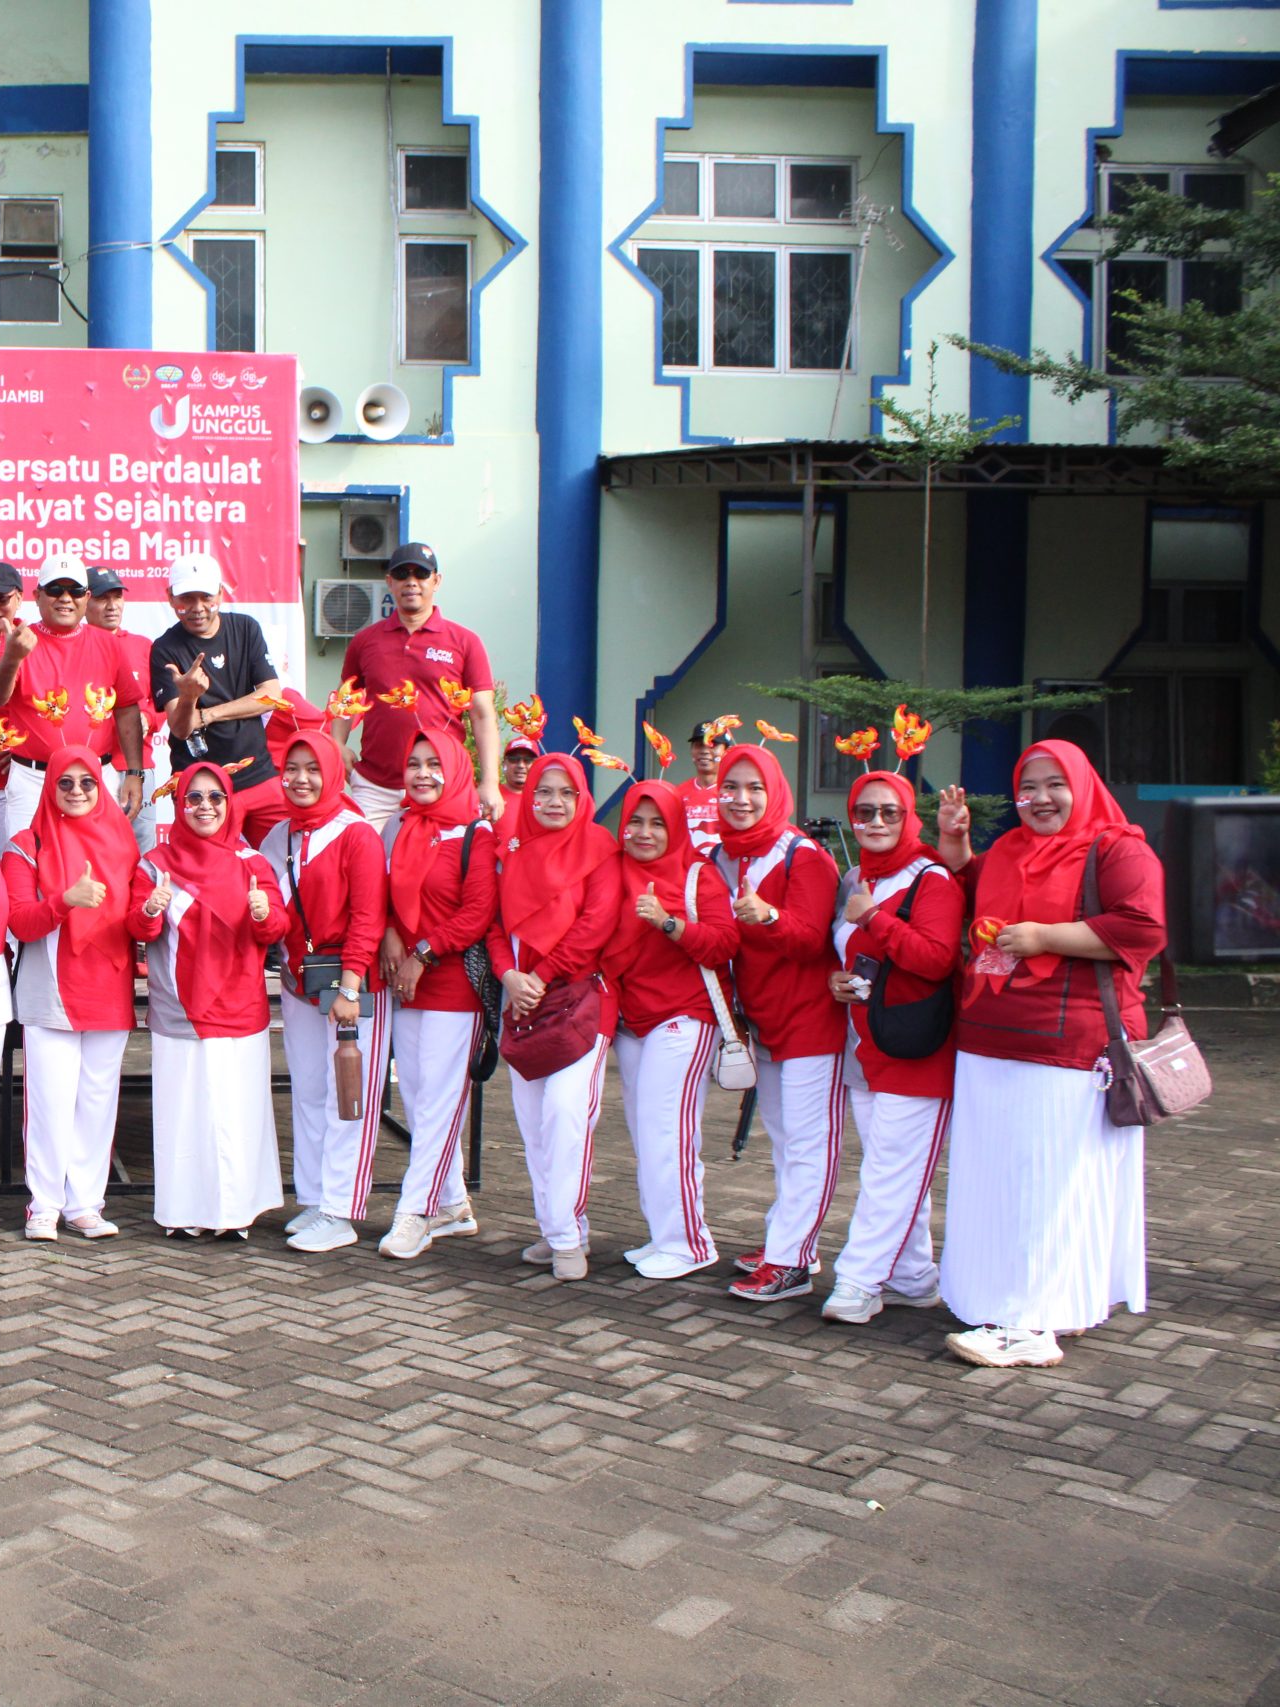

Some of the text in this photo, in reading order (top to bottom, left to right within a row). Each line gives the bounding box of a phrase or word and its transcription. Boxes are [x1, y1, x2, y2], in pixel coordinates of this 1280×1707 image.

[191, 403, 261, 418] KAMPUS
[191, 419, 272, 435] UNGGUL
[109, 453, 262, 484] Berdaulat
[94, 492, 247, 529] Sejahtera
[147, 567, 174, 578] 202
